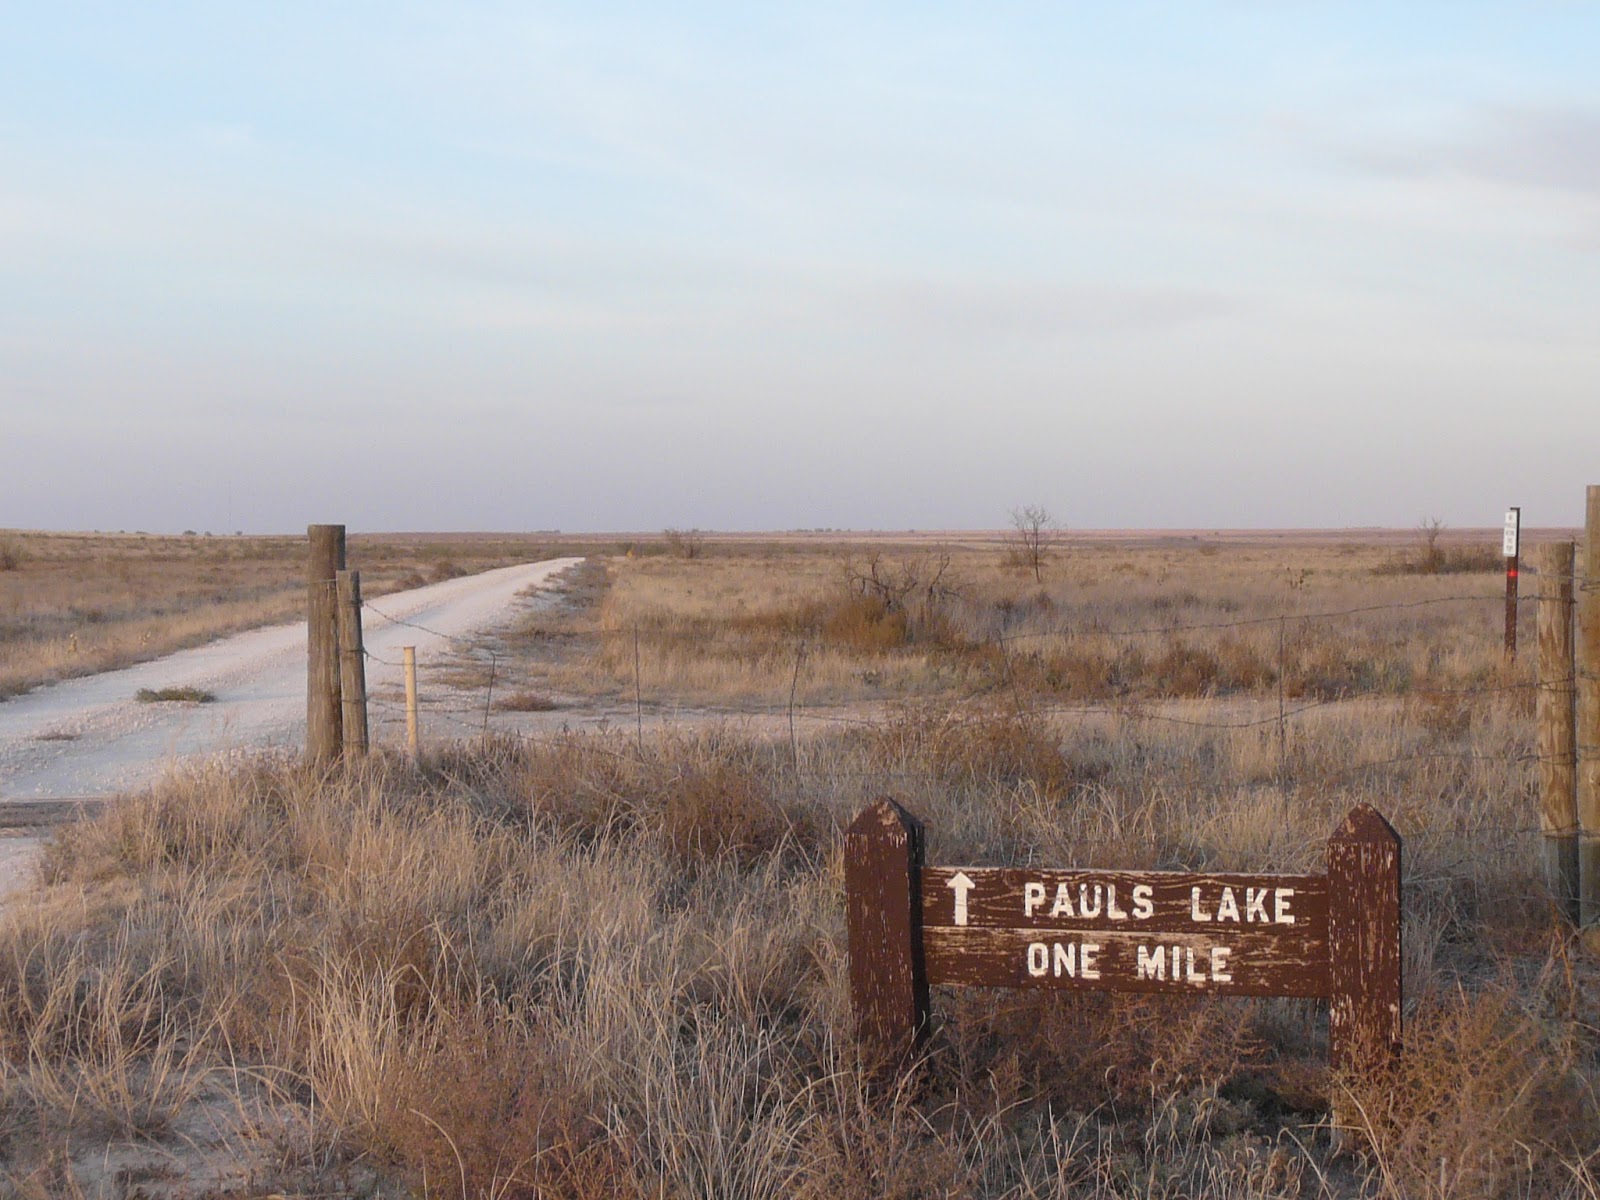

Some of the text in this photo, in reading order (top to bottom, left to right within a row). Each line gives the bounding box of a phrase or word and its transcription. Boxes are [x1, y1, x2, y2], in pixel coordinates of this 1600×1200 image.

[1024, 882, 1295, 924] PAULS LAKE
[1027, 942, 1234, 982] ONE MILE
